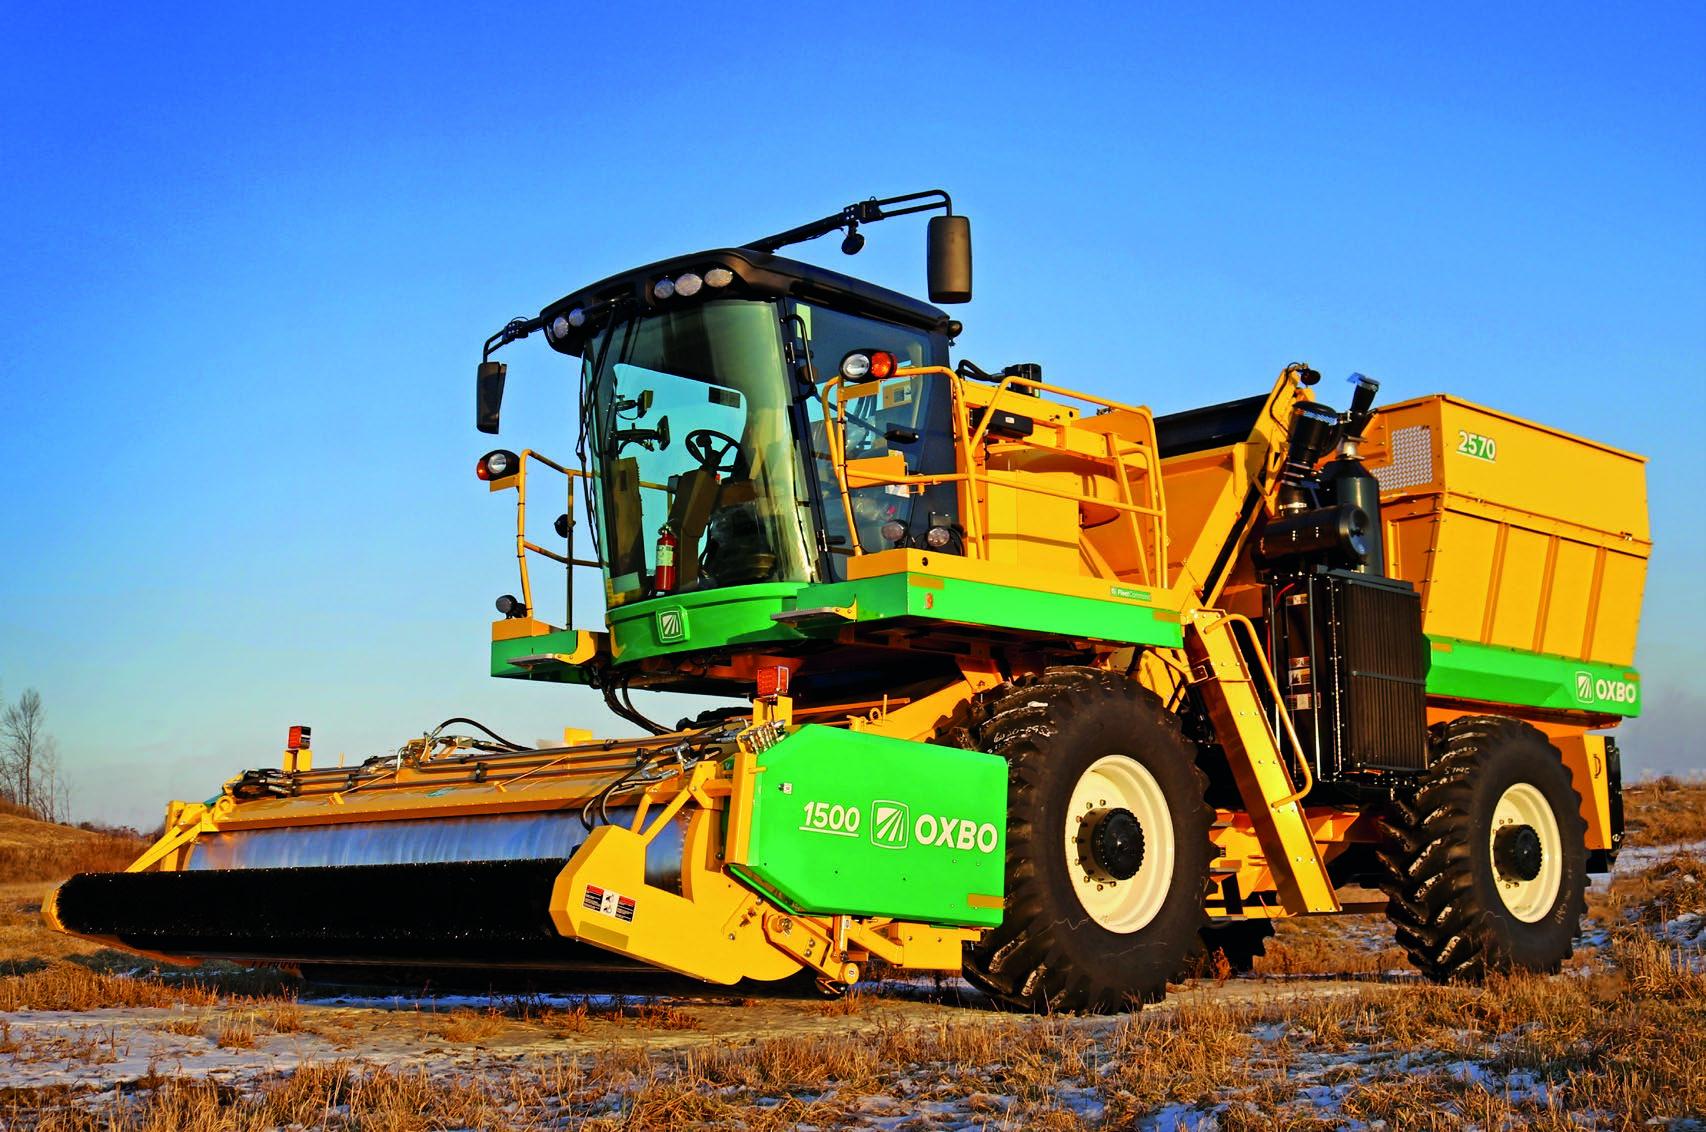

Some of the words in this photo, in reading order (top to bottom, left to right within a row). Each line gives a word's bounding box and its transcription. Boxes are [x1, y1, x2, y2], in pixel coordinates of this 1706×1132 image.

[1458, 430, 1496, 460] 2570
[1595, 678, 1636, 704] OXBO
[803, 801, 861, 832] 1500
[914, 813, 998, 853] OXBO
